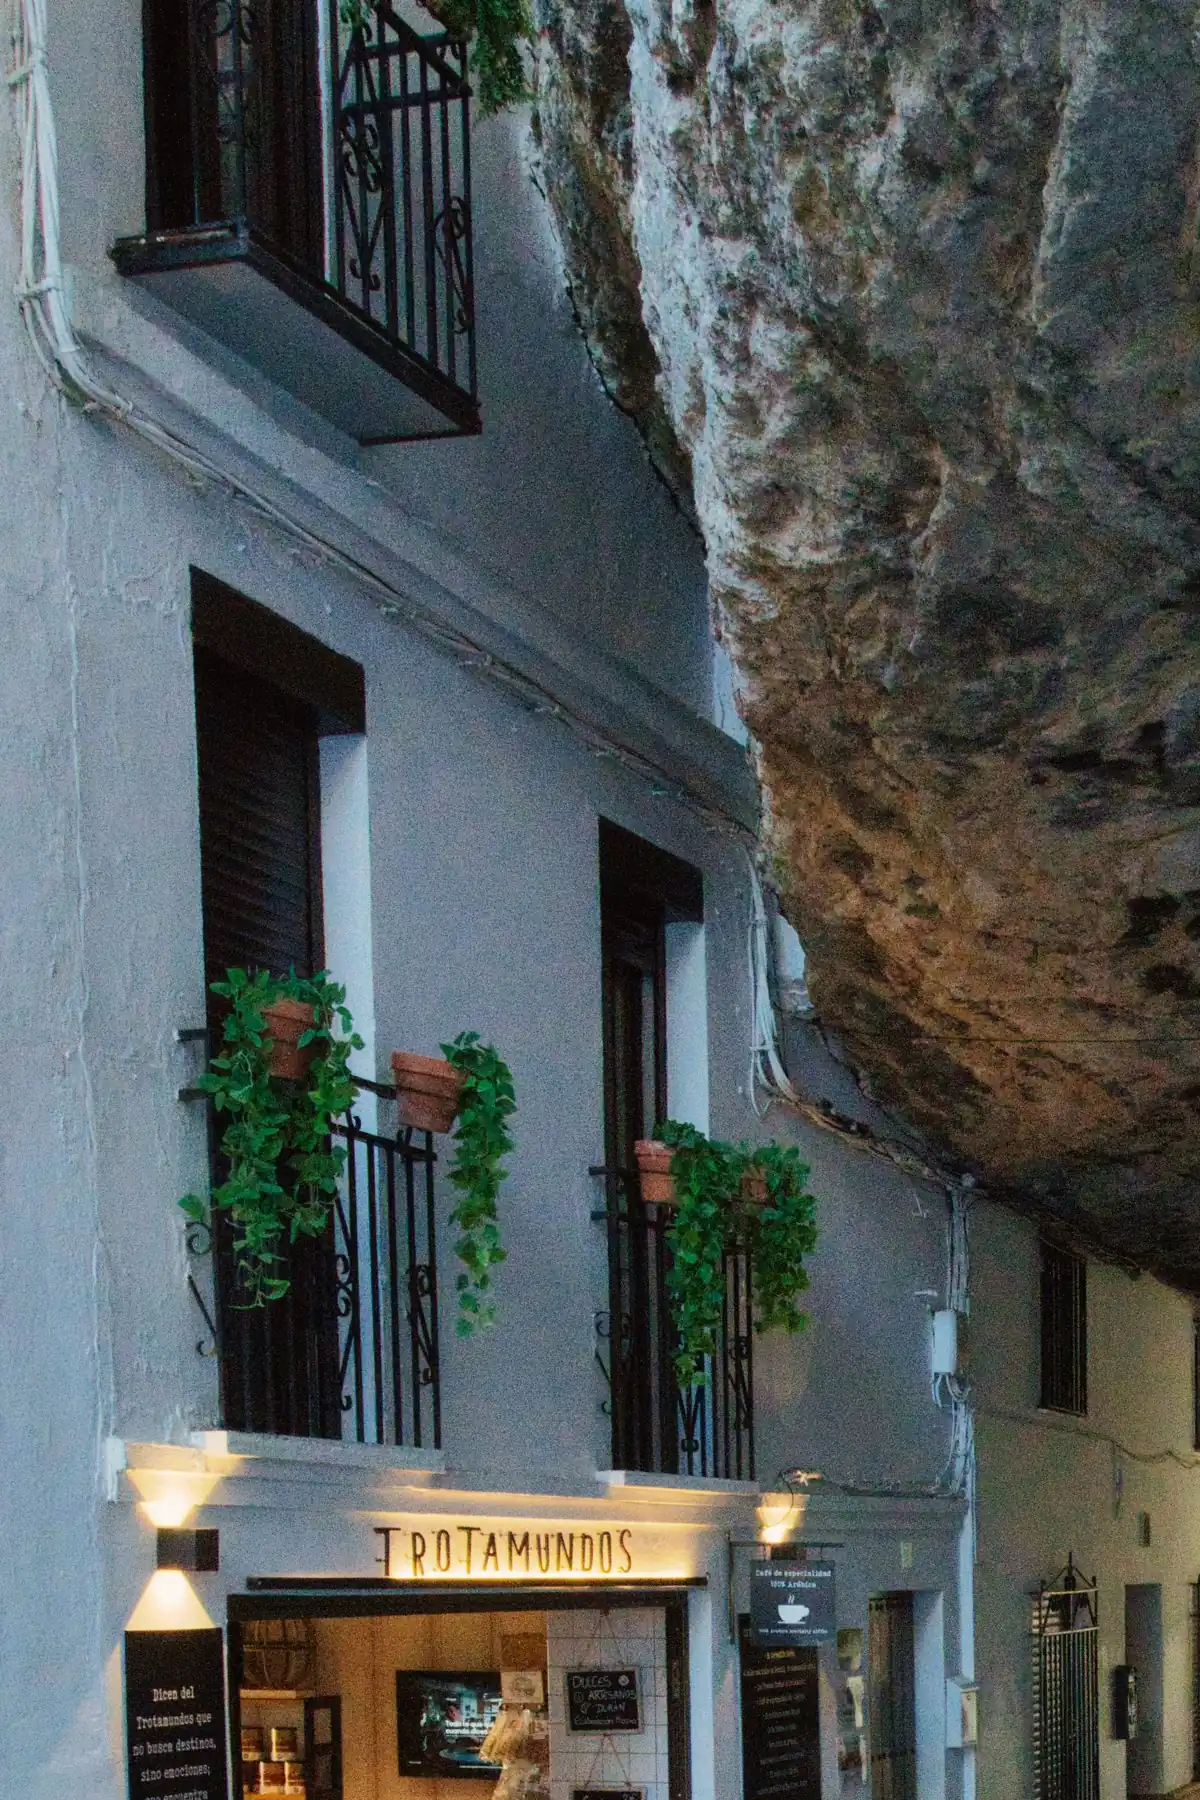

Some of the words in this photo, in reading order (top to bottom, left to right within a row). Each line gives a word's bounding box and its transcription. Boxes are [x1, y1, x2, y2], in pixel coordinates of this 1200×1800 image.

[373, 1526, 632, 1577] TROTAMUNDOS
[755, 1569, 772, 1577] Café
[784, 1569, 832, 1578] especialidad
[153, 1688, 178, 1702] Dicen
[180, 1685, 195, 1699] del
[136, 1713, 194, 1731] Trotamundos
[196, 1711, 212, 1727] que
[132, 1743, 144, 1757] no
[140, 1767, 162, 1782] sino
[164, 1763, 211, 1780] emociones;
